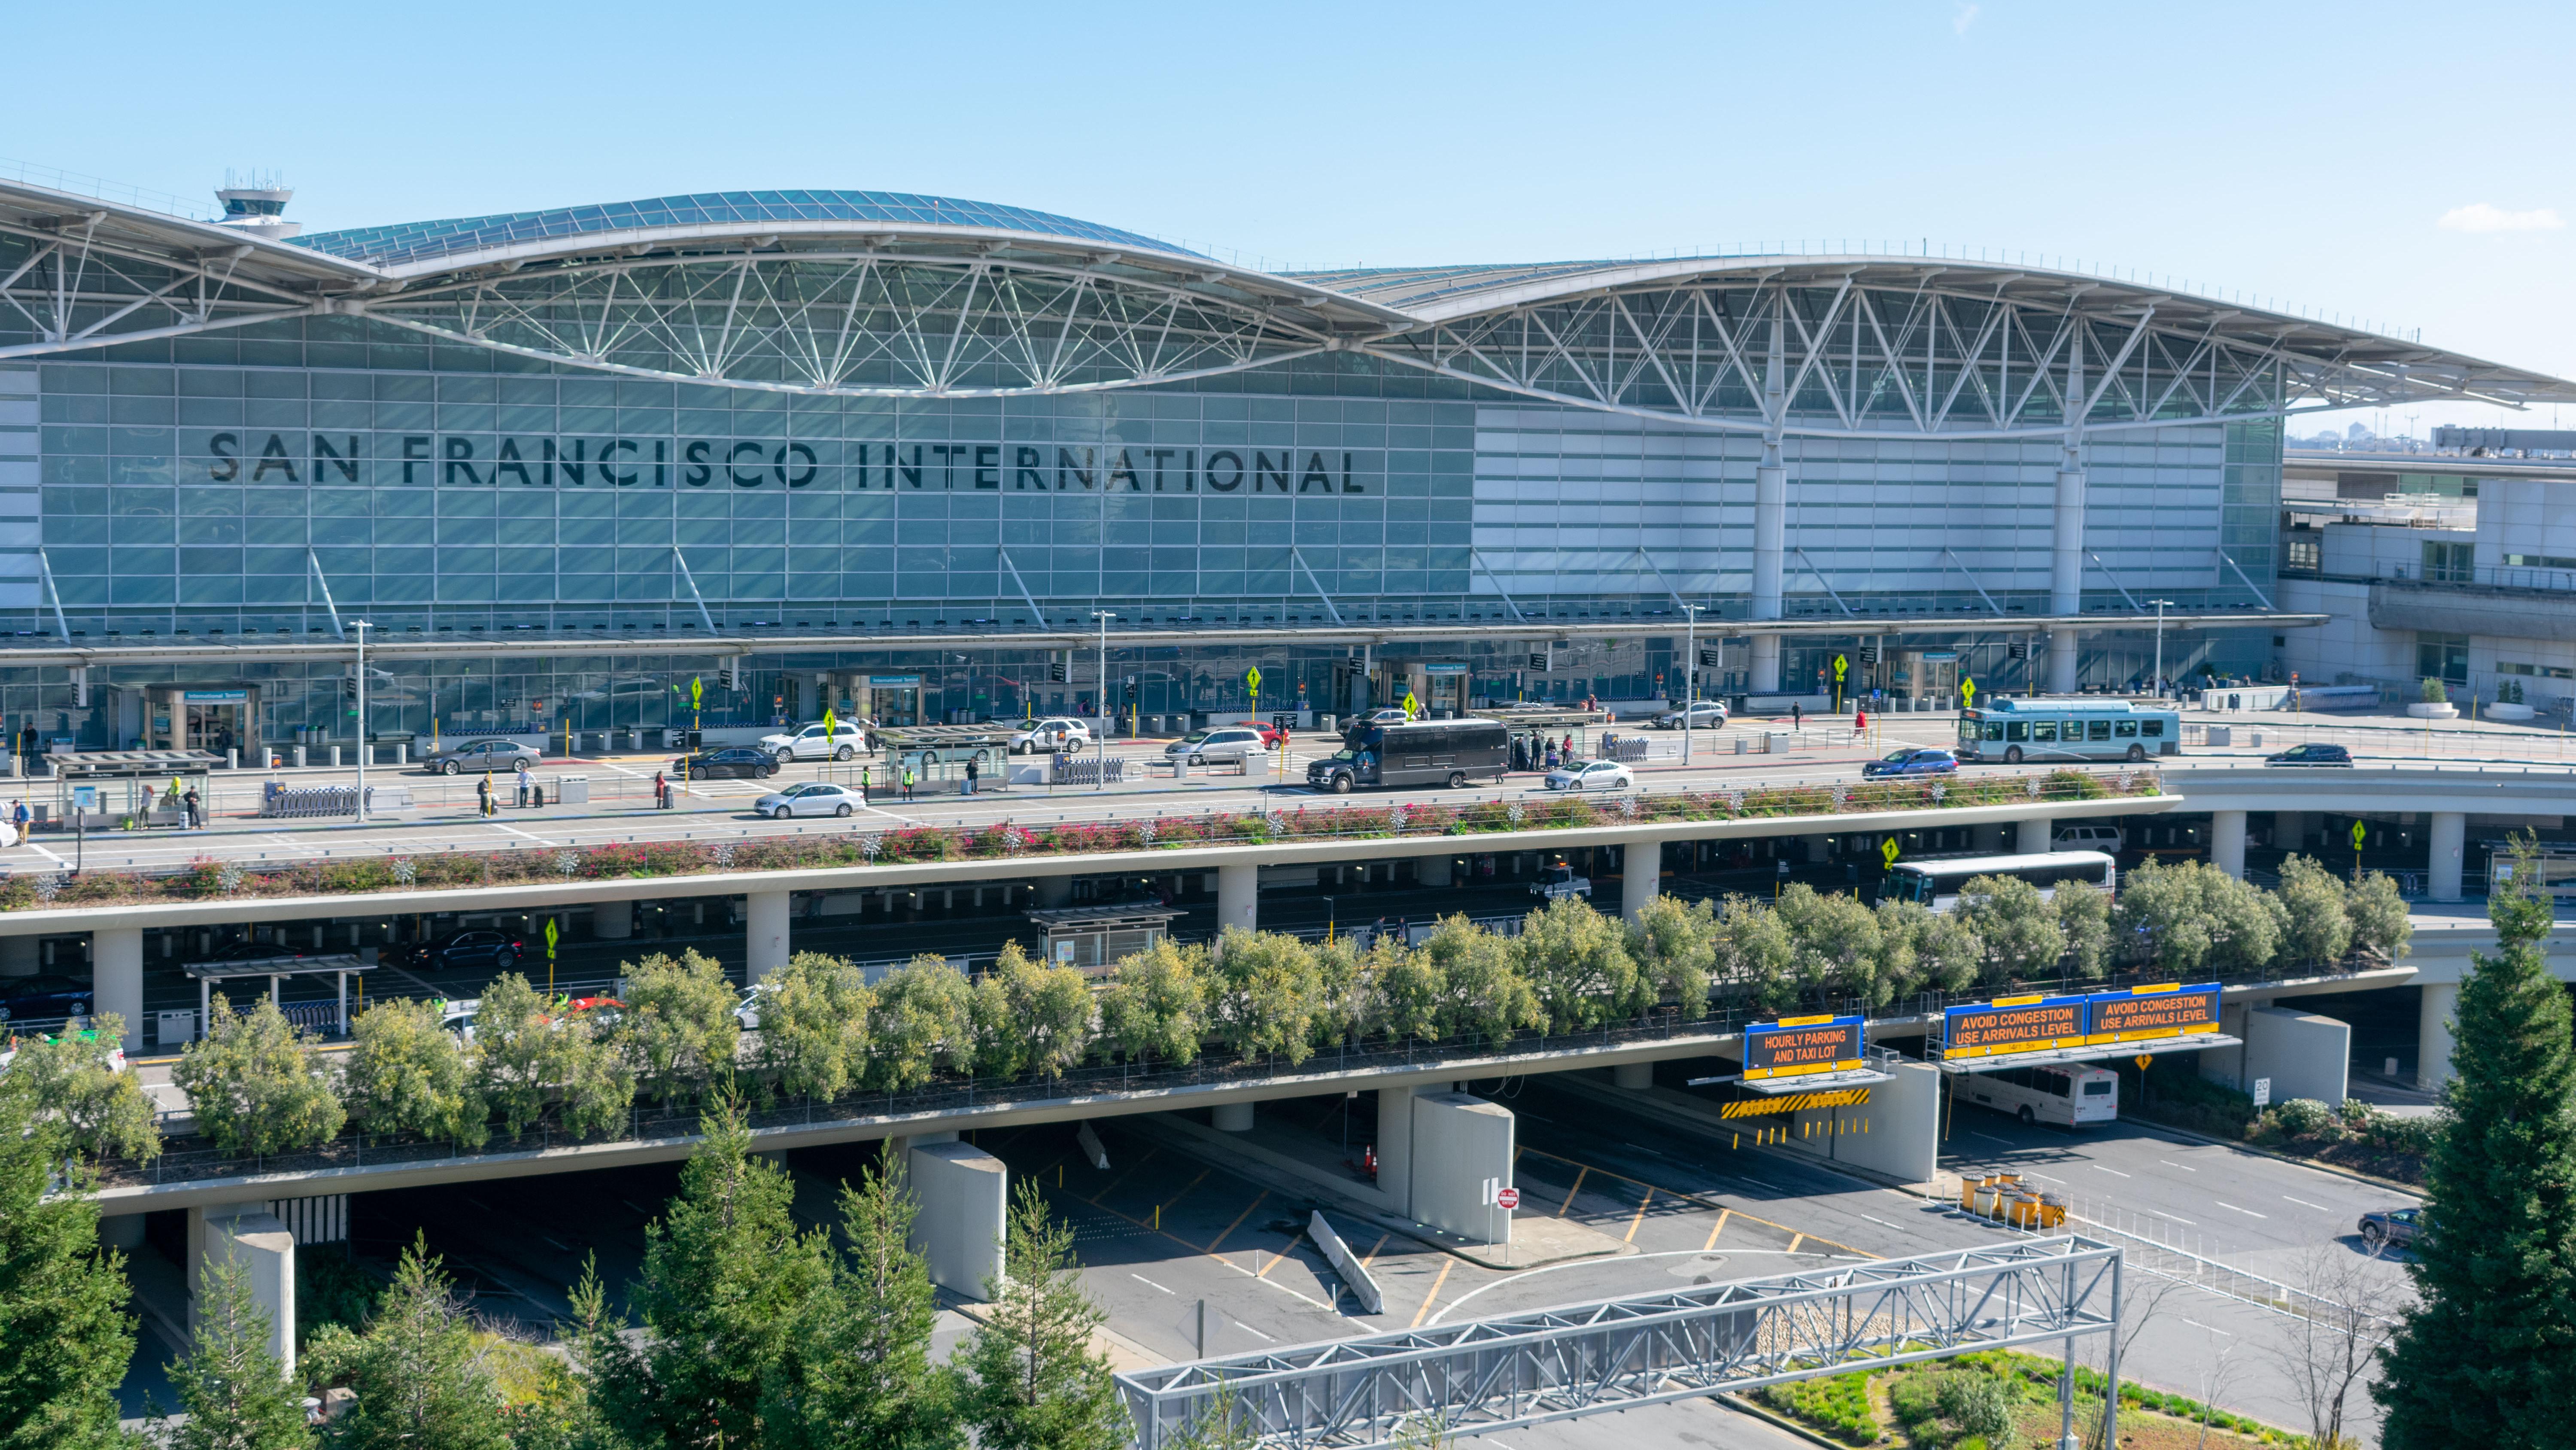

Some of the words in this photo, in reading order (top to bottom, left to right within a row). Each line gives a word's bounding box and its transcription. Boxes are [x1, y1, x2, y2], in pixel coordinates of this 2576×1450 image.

[209, 432, 359, 483] SAN
[403, 437, 817, 487] FRANCISCO
[859, 444, 1364, 492] INTERNATIONAL
[2106, 1002, 2137, 1015] AVOID
[2140, 995, 2206, 1012] CONGESTION
[1961, 1016, 1997, 1030] AVOID
[2000, 1008, 2073, 1026] CONGESTION
[2101, 1017, 2122, 1030] USE
[2124, 1012, 2175, 1027] ARRIVALS
[2177, 1009, 2208, 1023] LEVEL
[1765, 1034, 1803, 1049] HOURLY
[1804, 1030, 1846, 1045] PARKING
[1956, 1031, 1979, 1045] USE
[1981, 1026, 2038, 1042] ARRIVALS
[2041, 1022, 2076, 1036] LEVEL
[1774, 1050, 1794, 1063] AND
[1796, 1047, 1817, 1060] TAXI
[1819, 1046, 1837, 1058] LOT
[2256, 1081, 2268, 1091] 20
